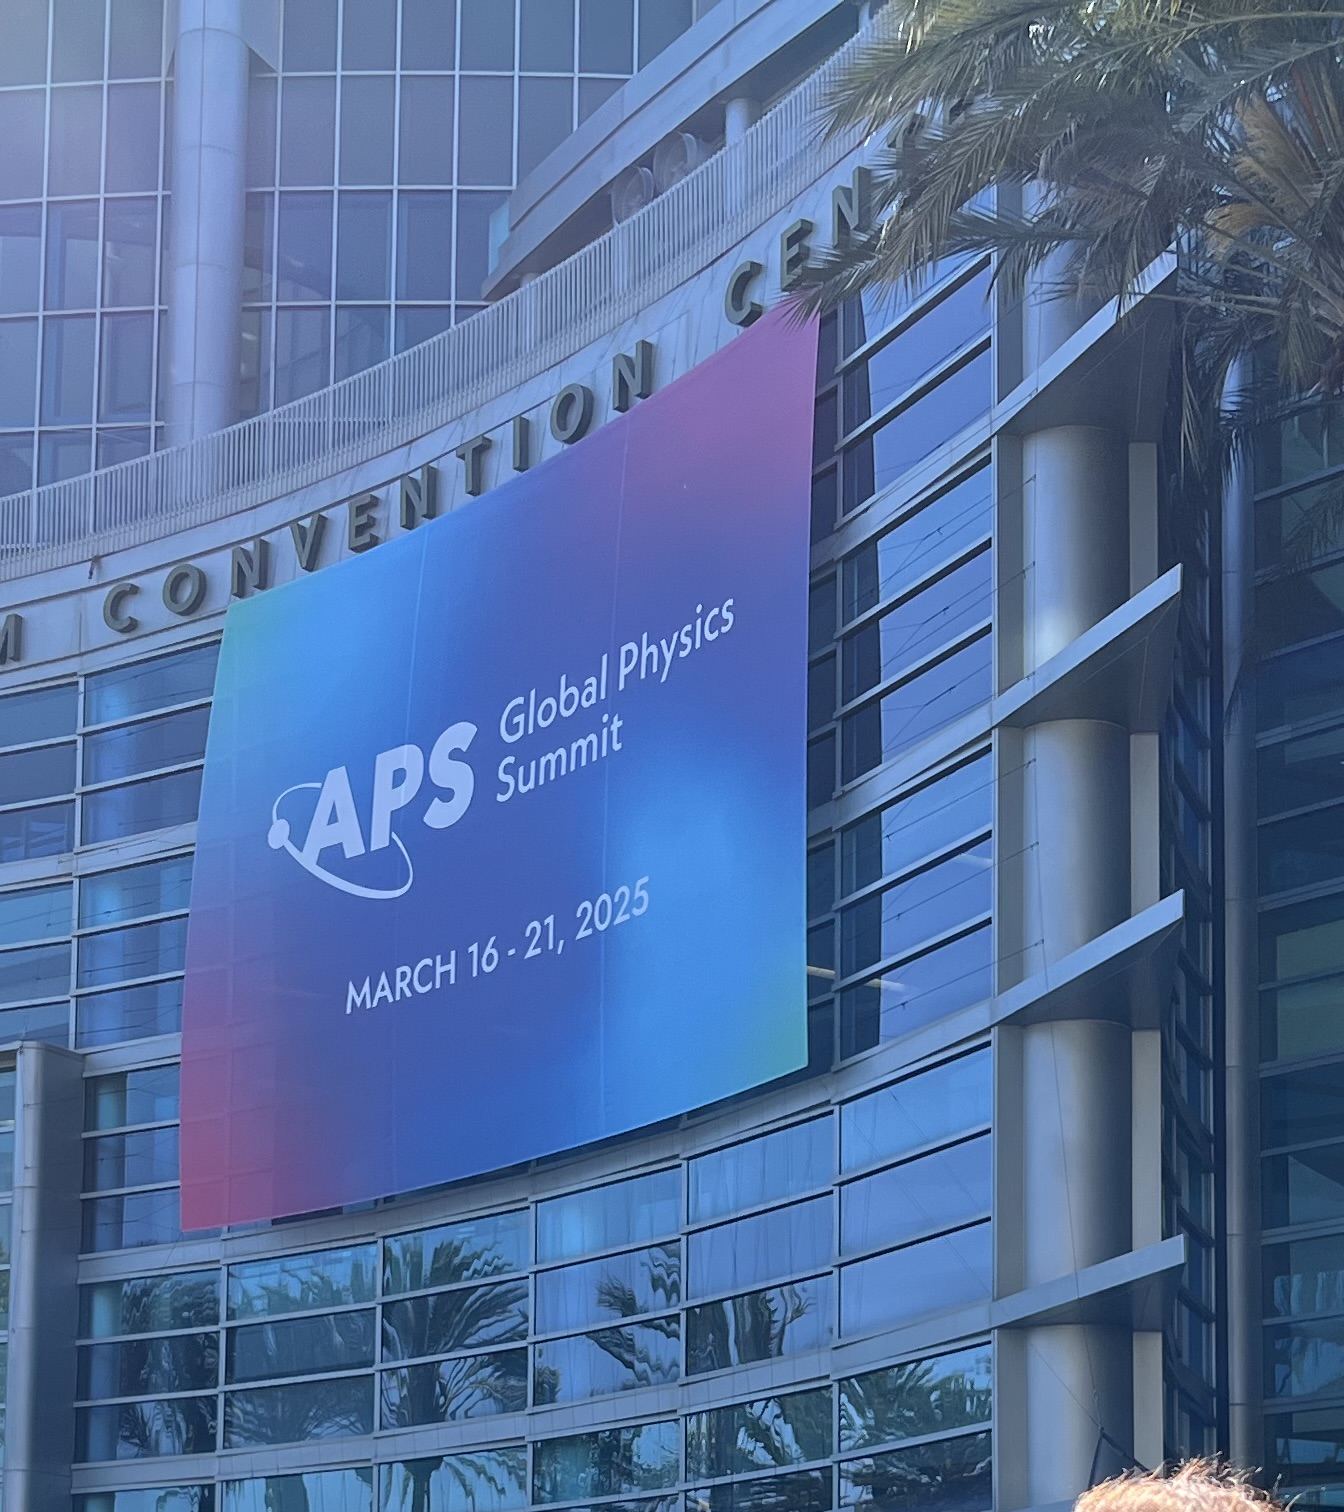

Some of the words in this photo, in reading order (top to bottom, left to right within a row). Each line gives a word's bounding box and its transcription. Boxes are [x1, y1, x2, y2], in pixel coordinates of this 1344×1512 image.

[103, 339, 654, 633] CONVENTION
[498, 653, 608, 744] Global
[618, 597, 736, 692] Physics
[301, 721, 478, 866] APS
[495, 713, 624, 802] Summit
[345, 950, 457, 1015] MARCH
[467, 936, 499, 980] 16
[575, 876, 651, 941] 2025
